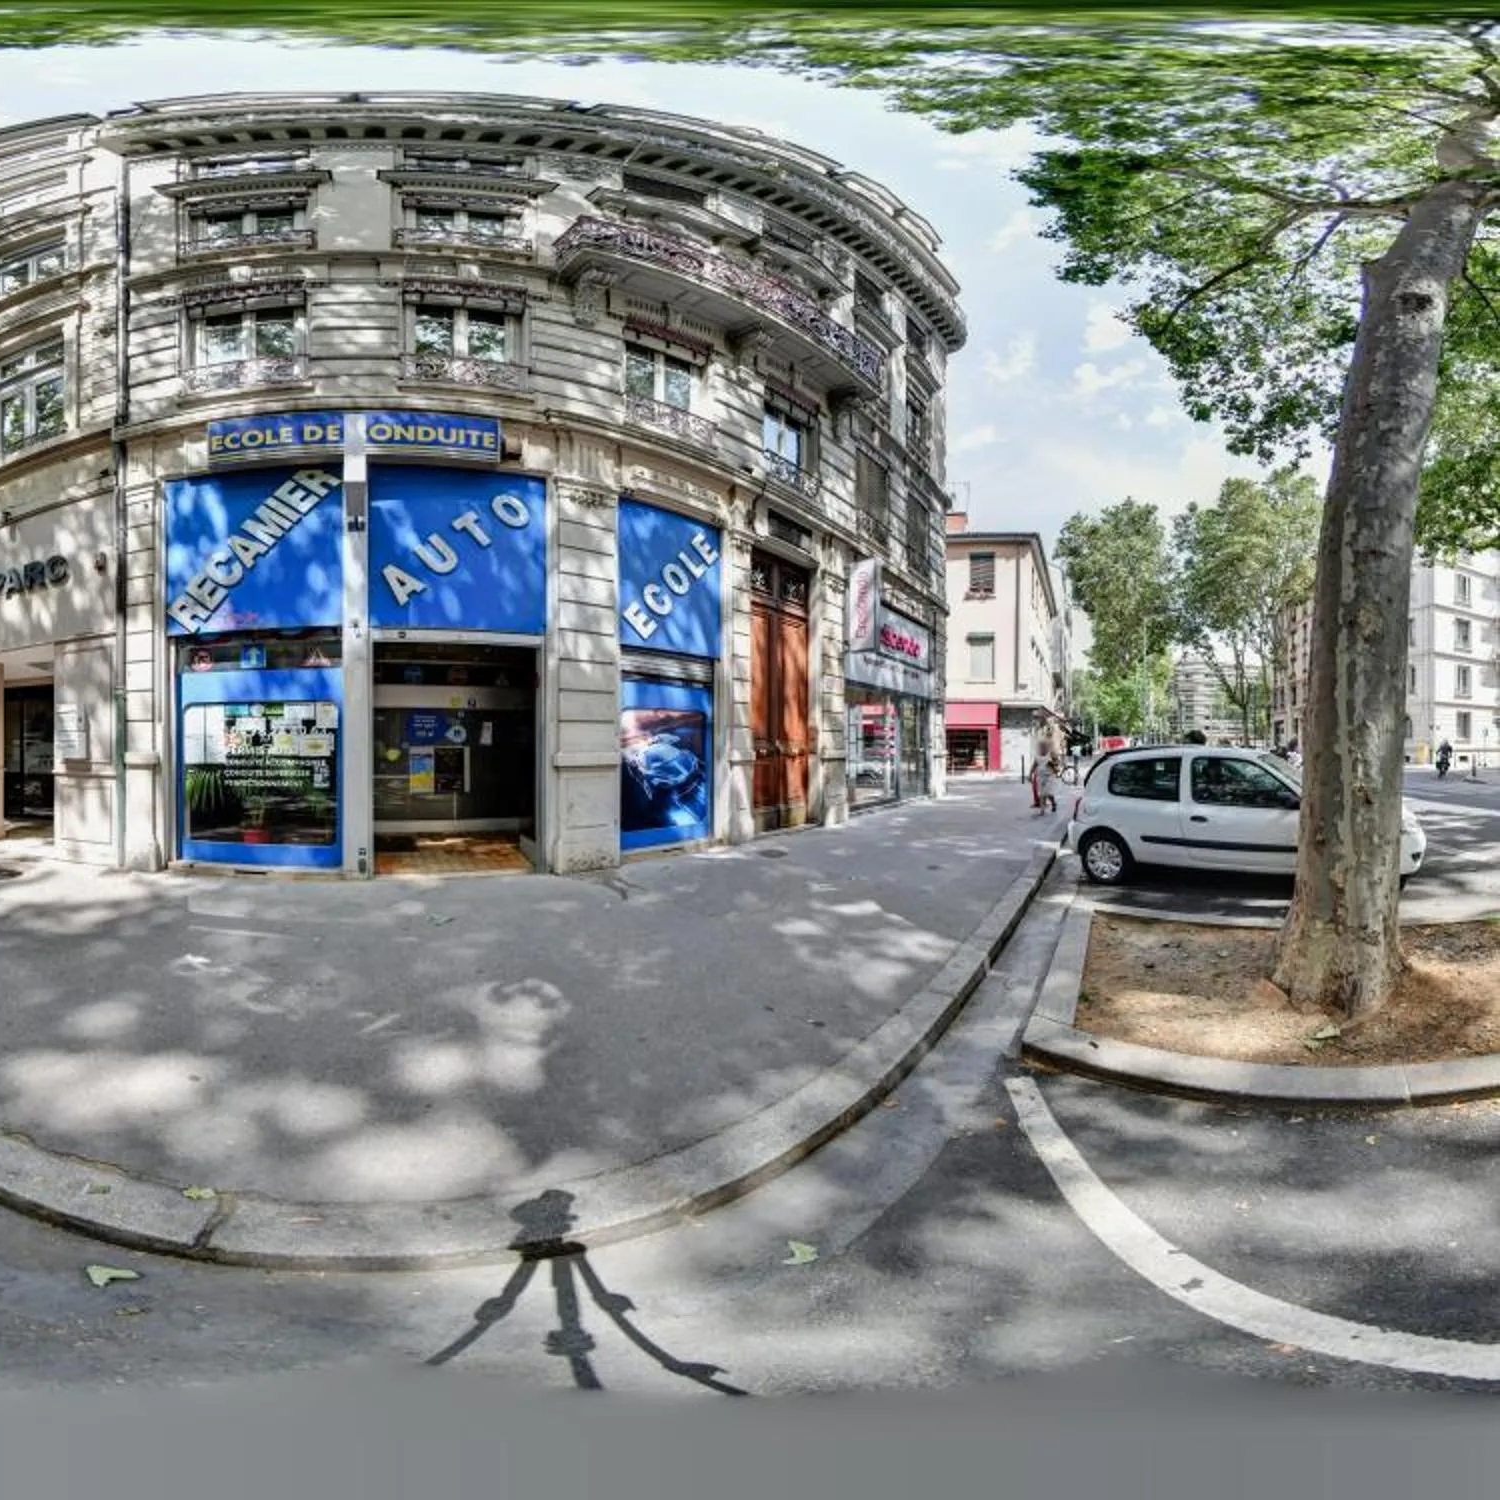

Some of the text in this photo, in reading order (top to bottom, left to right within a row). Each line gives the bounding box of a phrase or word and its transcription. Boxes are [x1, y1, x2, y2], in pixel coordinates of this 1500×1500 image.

[211, 423, 497, 451] ECOLE DE ONDUITE
[166, 468, 343, 635] RECAMIER
[381, 492, 532, 607] AUTO
[621, 531, 721, 641] ECOLE
